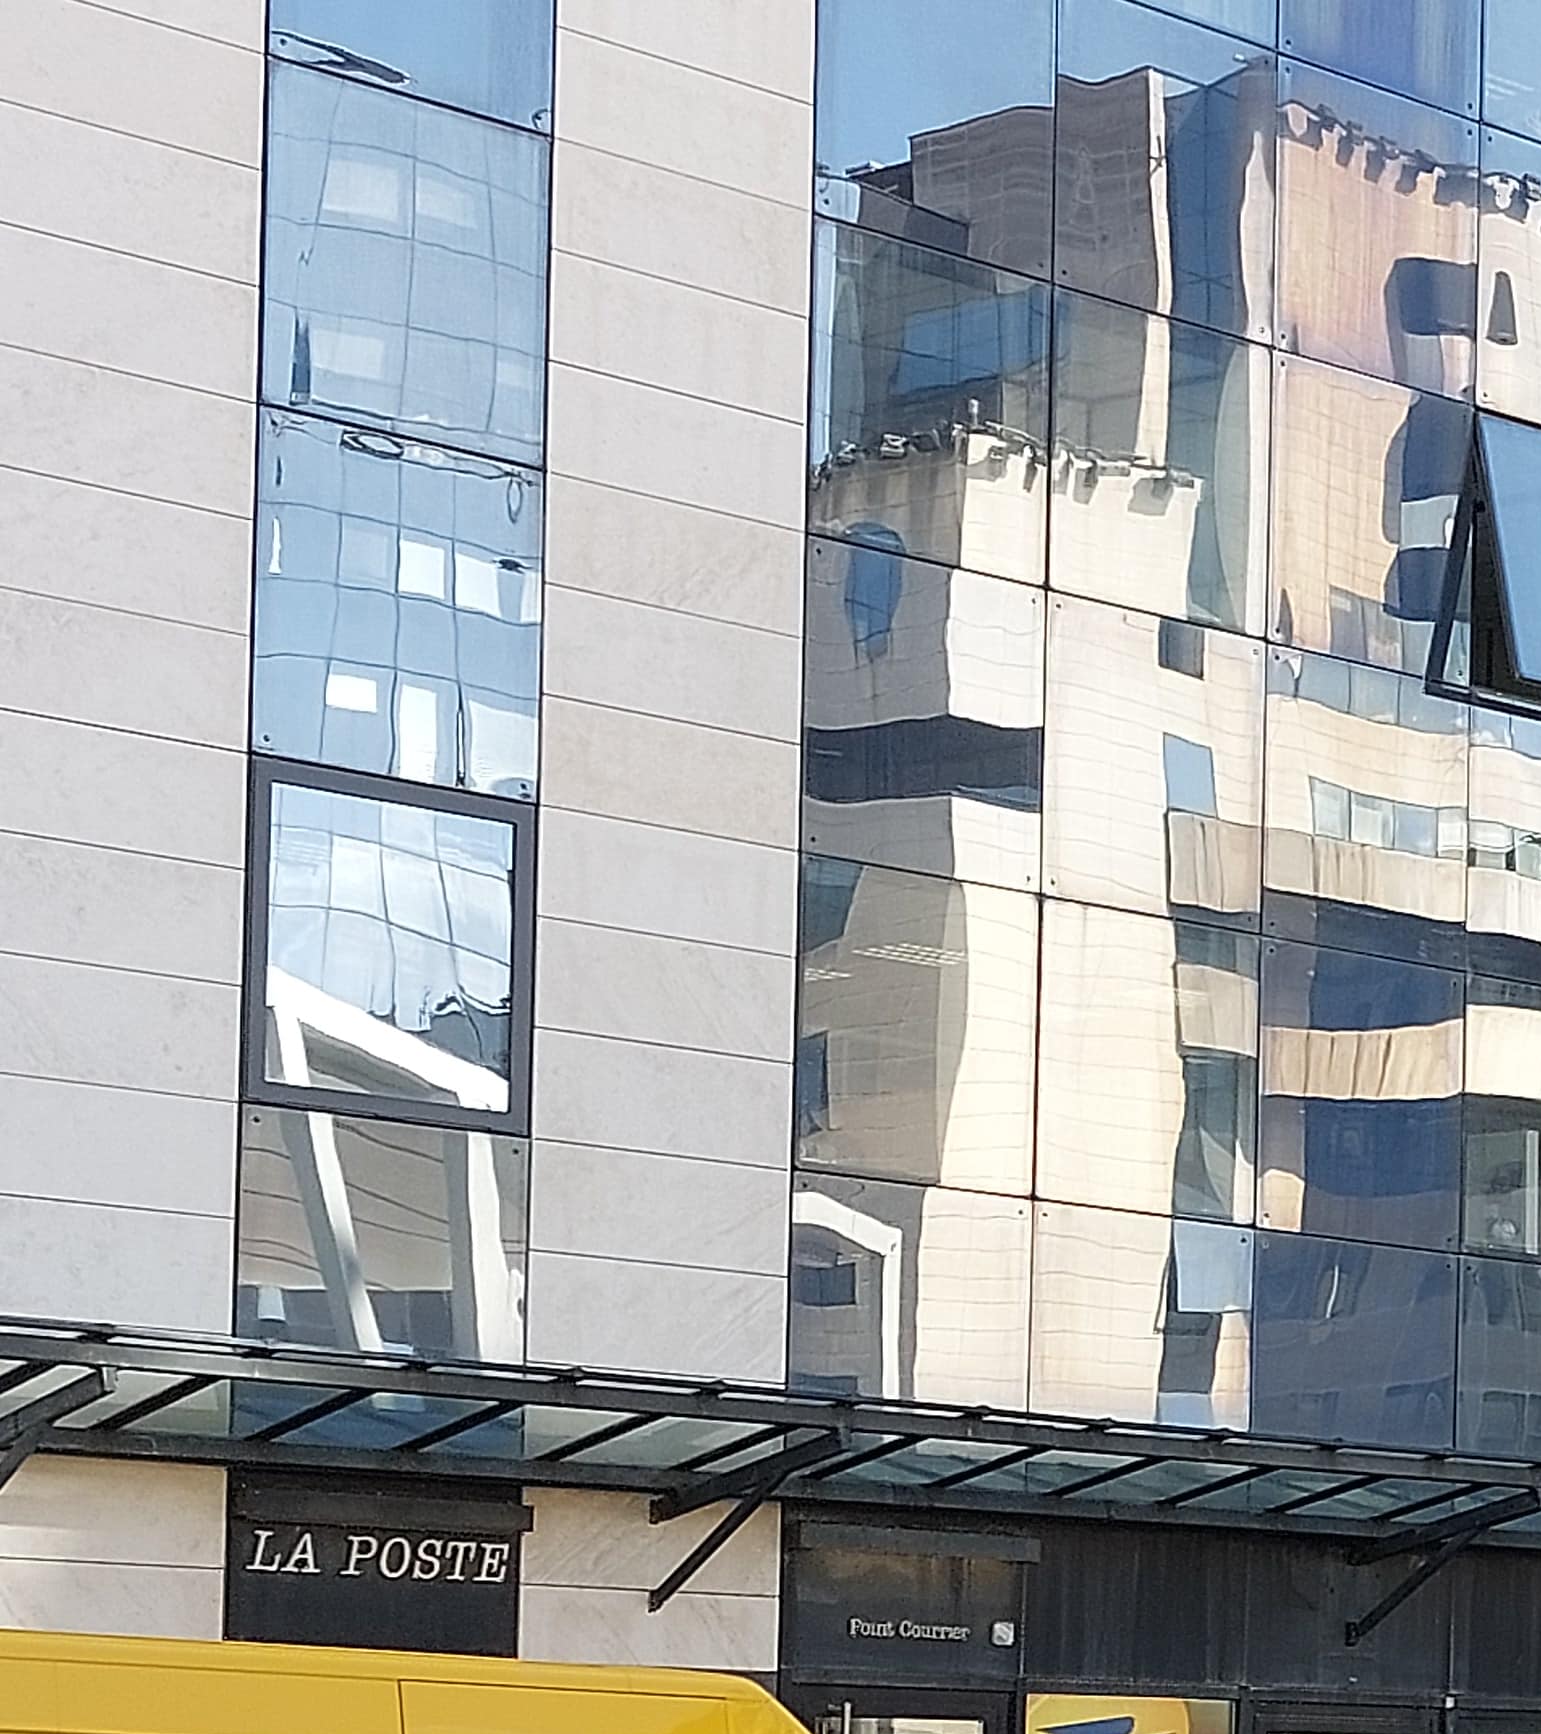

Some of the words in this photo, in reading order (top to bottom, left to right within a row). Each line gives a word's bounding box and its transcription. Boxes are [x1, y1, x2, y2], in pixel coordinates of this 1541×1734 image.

[246, 1530, 320, 1573] LA
[340, 1534, 510, 1582] POSTE
[850, 1618, 895, 1638] Point
[899, 1620, 971, 1641] Courrier
